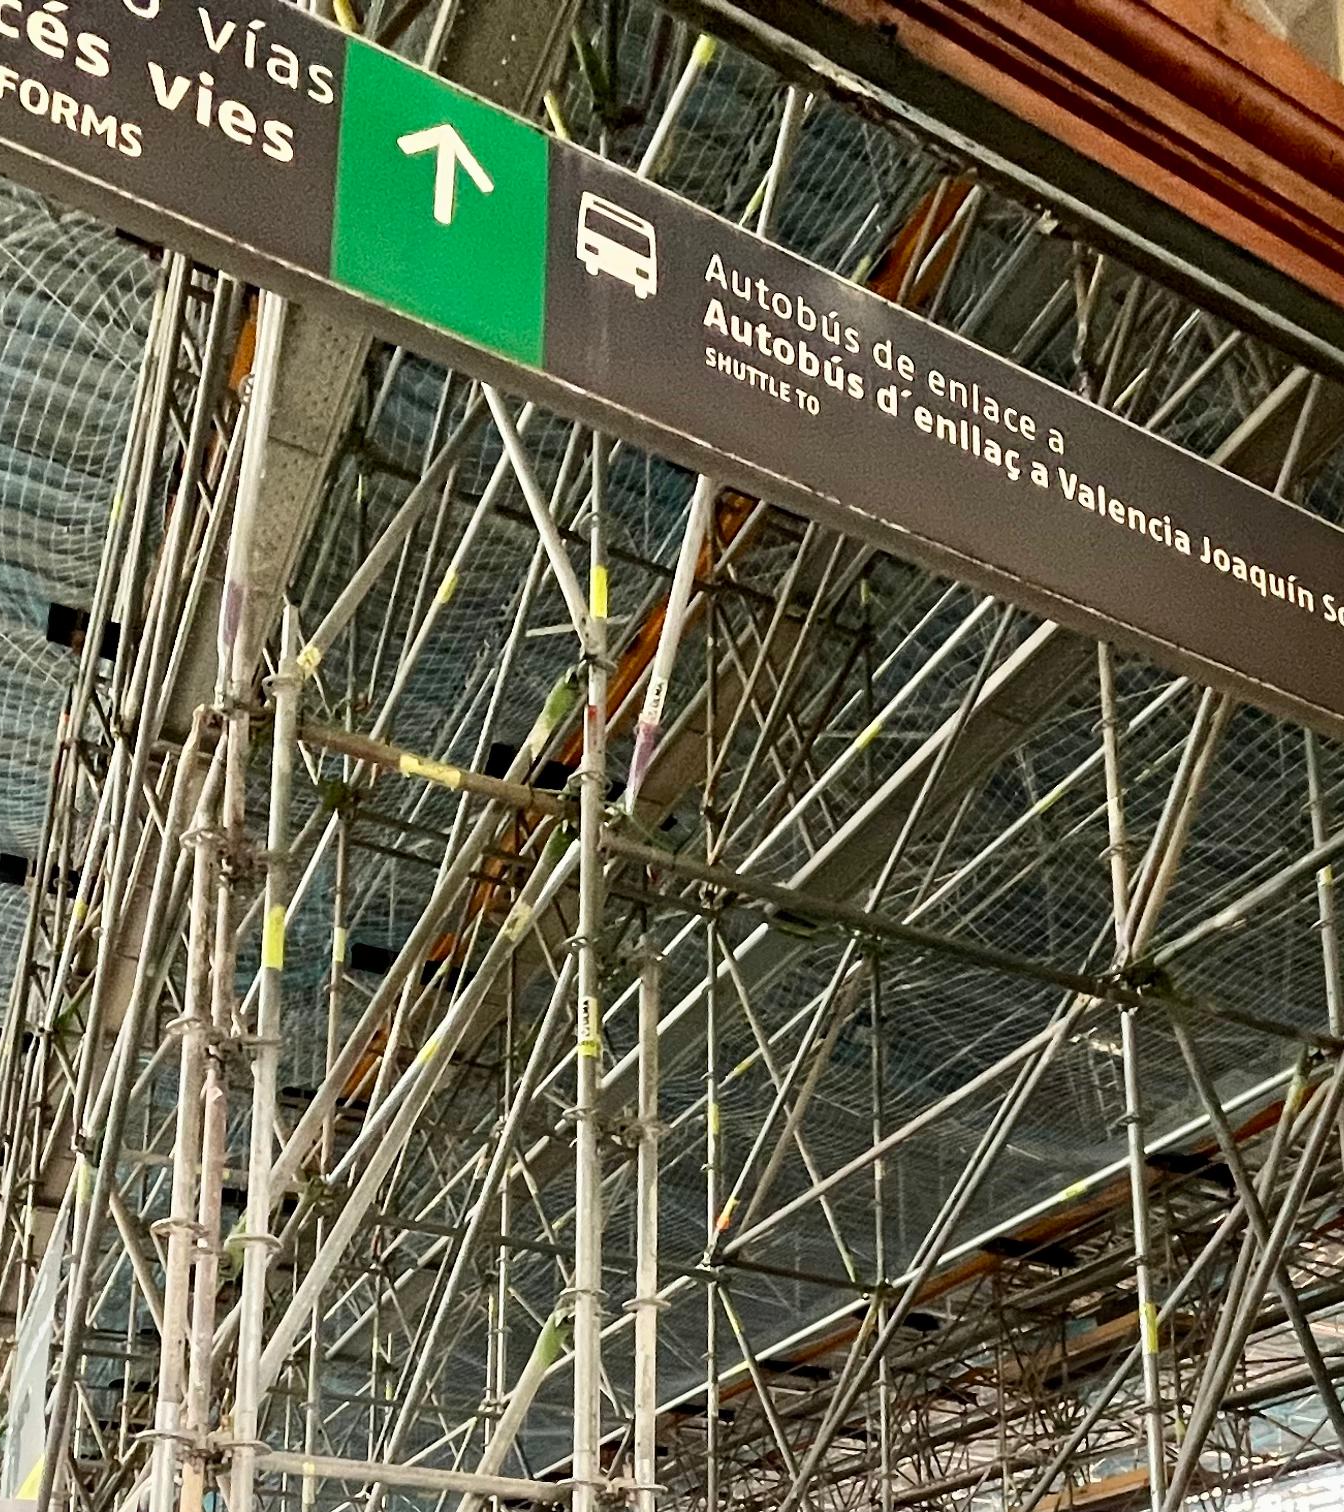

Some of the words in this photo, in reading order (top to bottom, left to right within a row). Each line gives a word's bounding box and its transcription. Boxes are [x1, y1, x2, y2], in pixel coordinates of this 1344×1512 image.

[197, 7, 335, 104] vías
[148, 61, 296, 163] vies
[704, 253, 860, 354] Autobús
[873, 340, 915, 382] de
[928, 369, 1036, 441] enlace
[1048, 427, 1065, 455] a
[705, 347, 791, 403] SHUTTLE
[795, 388, 821, 416] TO
[703, 298, 865, 400] Autobús
[1030, 460, 1049, 488] a
[1058, 466, 1191, 556] Valencia
[1199, 536, 1315, 613] Joaquín
